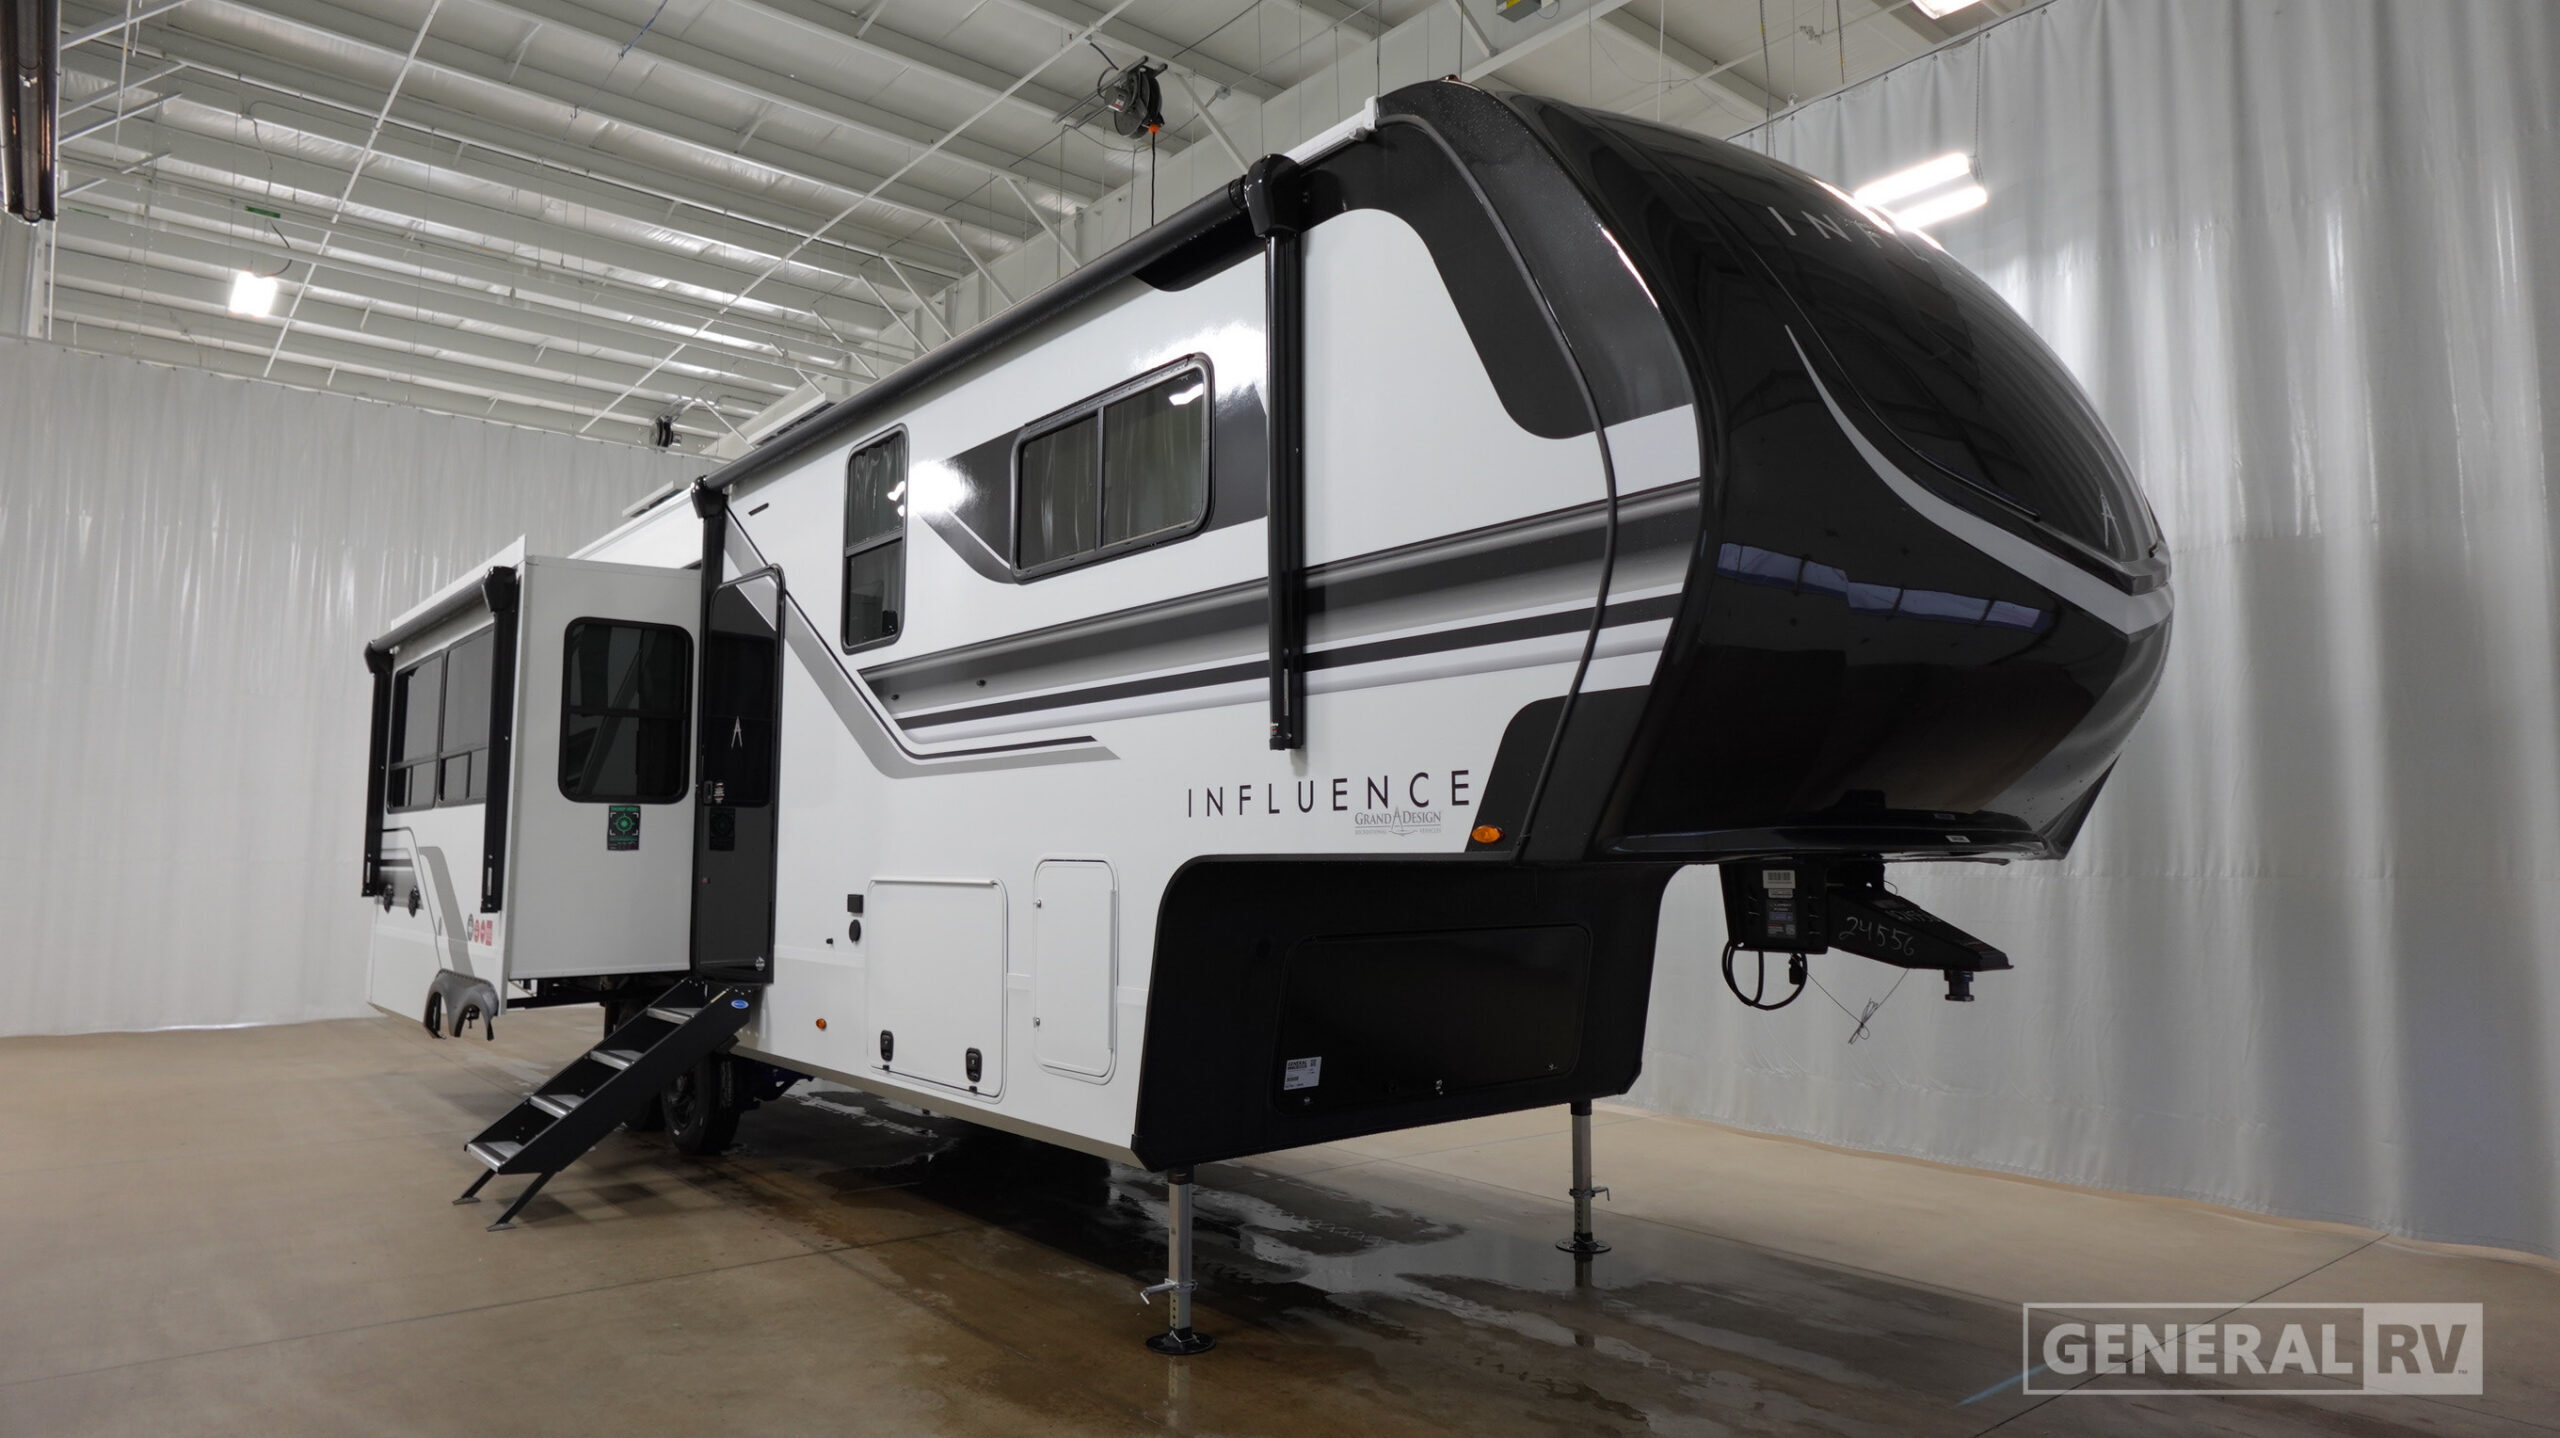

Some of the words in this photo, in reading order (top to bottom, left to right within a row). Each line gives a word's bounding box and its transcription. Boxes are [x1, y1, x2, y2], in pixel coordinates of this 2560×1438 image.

[1188, 770, 1469, 818] INFLUENCE
[1354, 812, 1392, 825] GRAND
[1402, 810, 1441, 824] DESIGN
[1838, 916, 1914, 956] 24556
